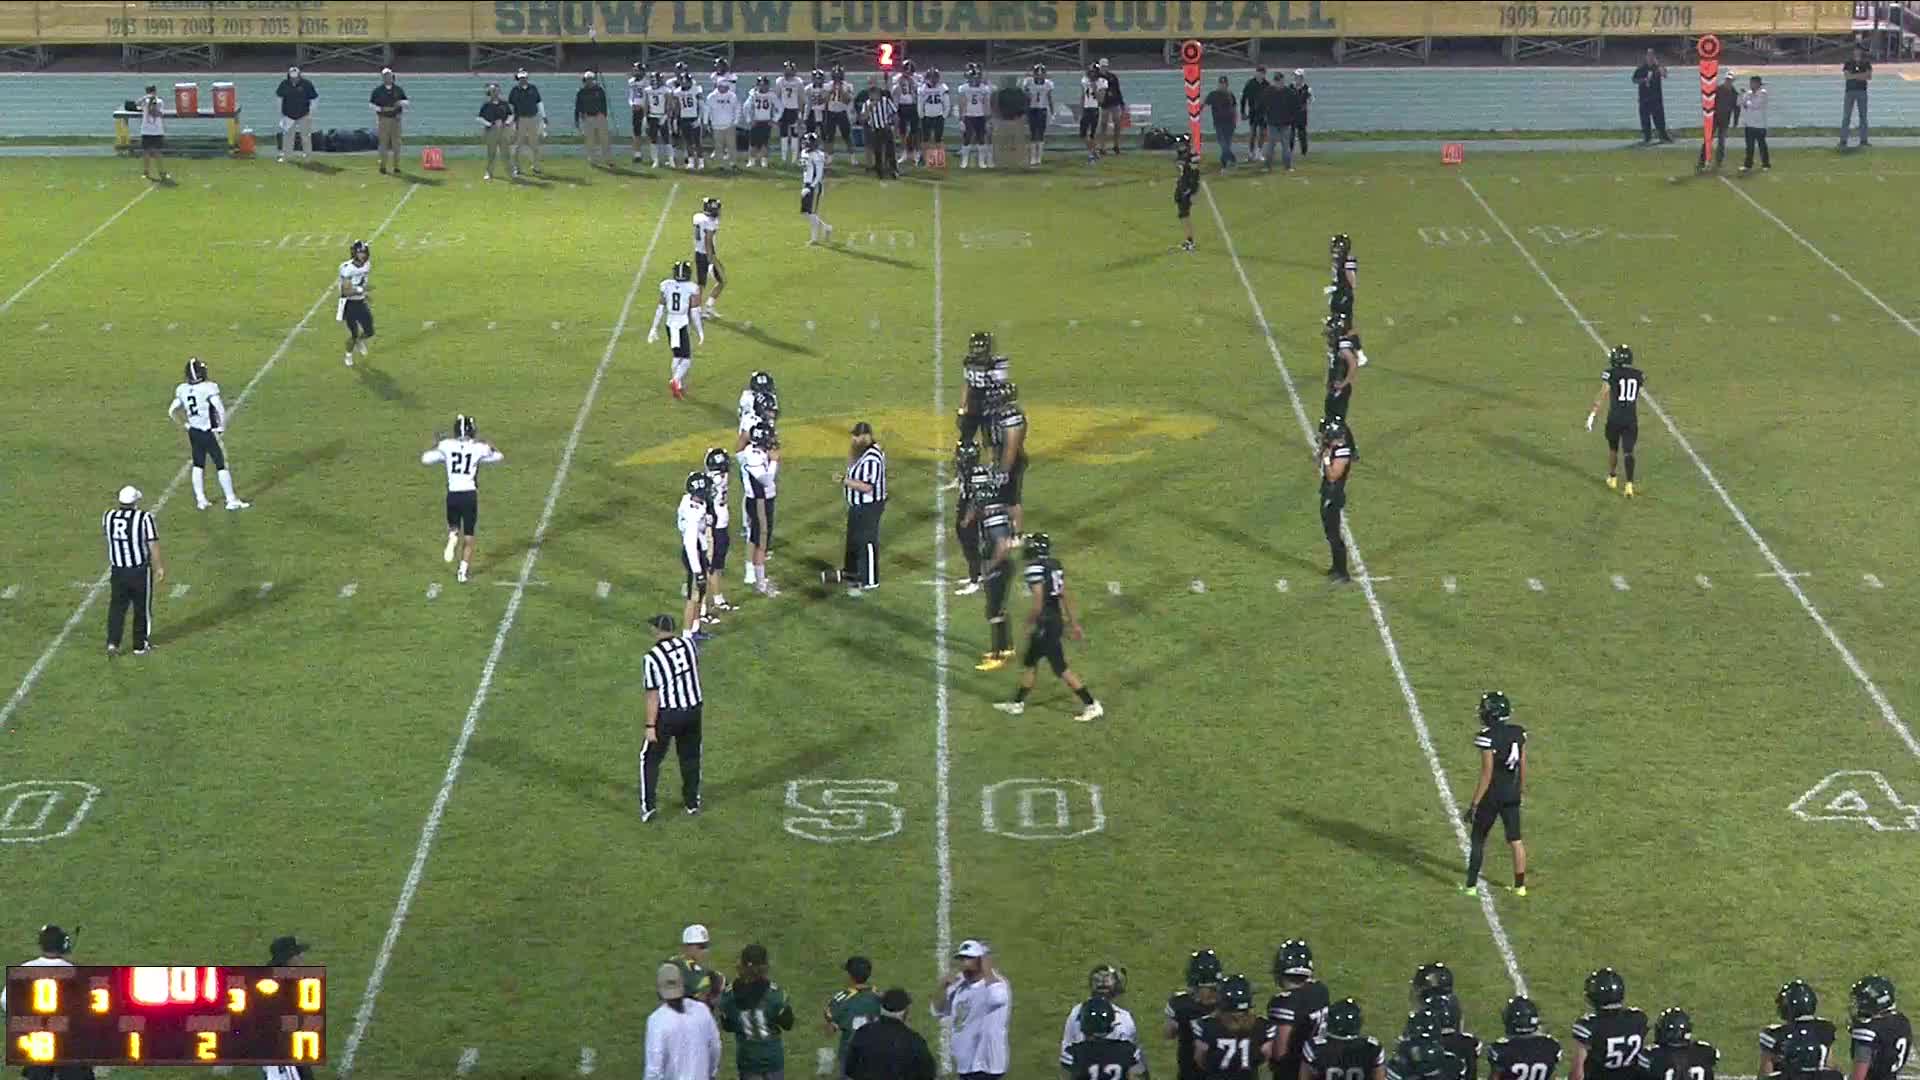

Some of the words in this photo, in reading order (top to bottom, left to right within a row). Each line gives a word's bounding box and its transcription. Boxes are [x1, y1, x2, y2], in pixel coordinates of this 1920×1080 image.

[494, 2, 654, 34] SHOW
[671, 2, 793, 34] LOW
[812, 2, 1060, 34] COUGARS
[1072, 2, 1336, 33] FOOTBALL
[879, 43, 894, 65] 2
[926, 94, 942, 105] 46
[671, 292, 682, 311] 8
[1618, 378, 1638, 402] 10
[187, 395, 199, 417] 2
[451, 451, 473, 475] 21
[111, 517, 128, 540] R
[669, 646, 690, 675] H
[1506, 741, 1520, 771] 4
[1216, 1039, 1251, 1070] 71
[1605, 1034, 1642, 1069] 52
[1890, 1037, 1908, 1072] 3
